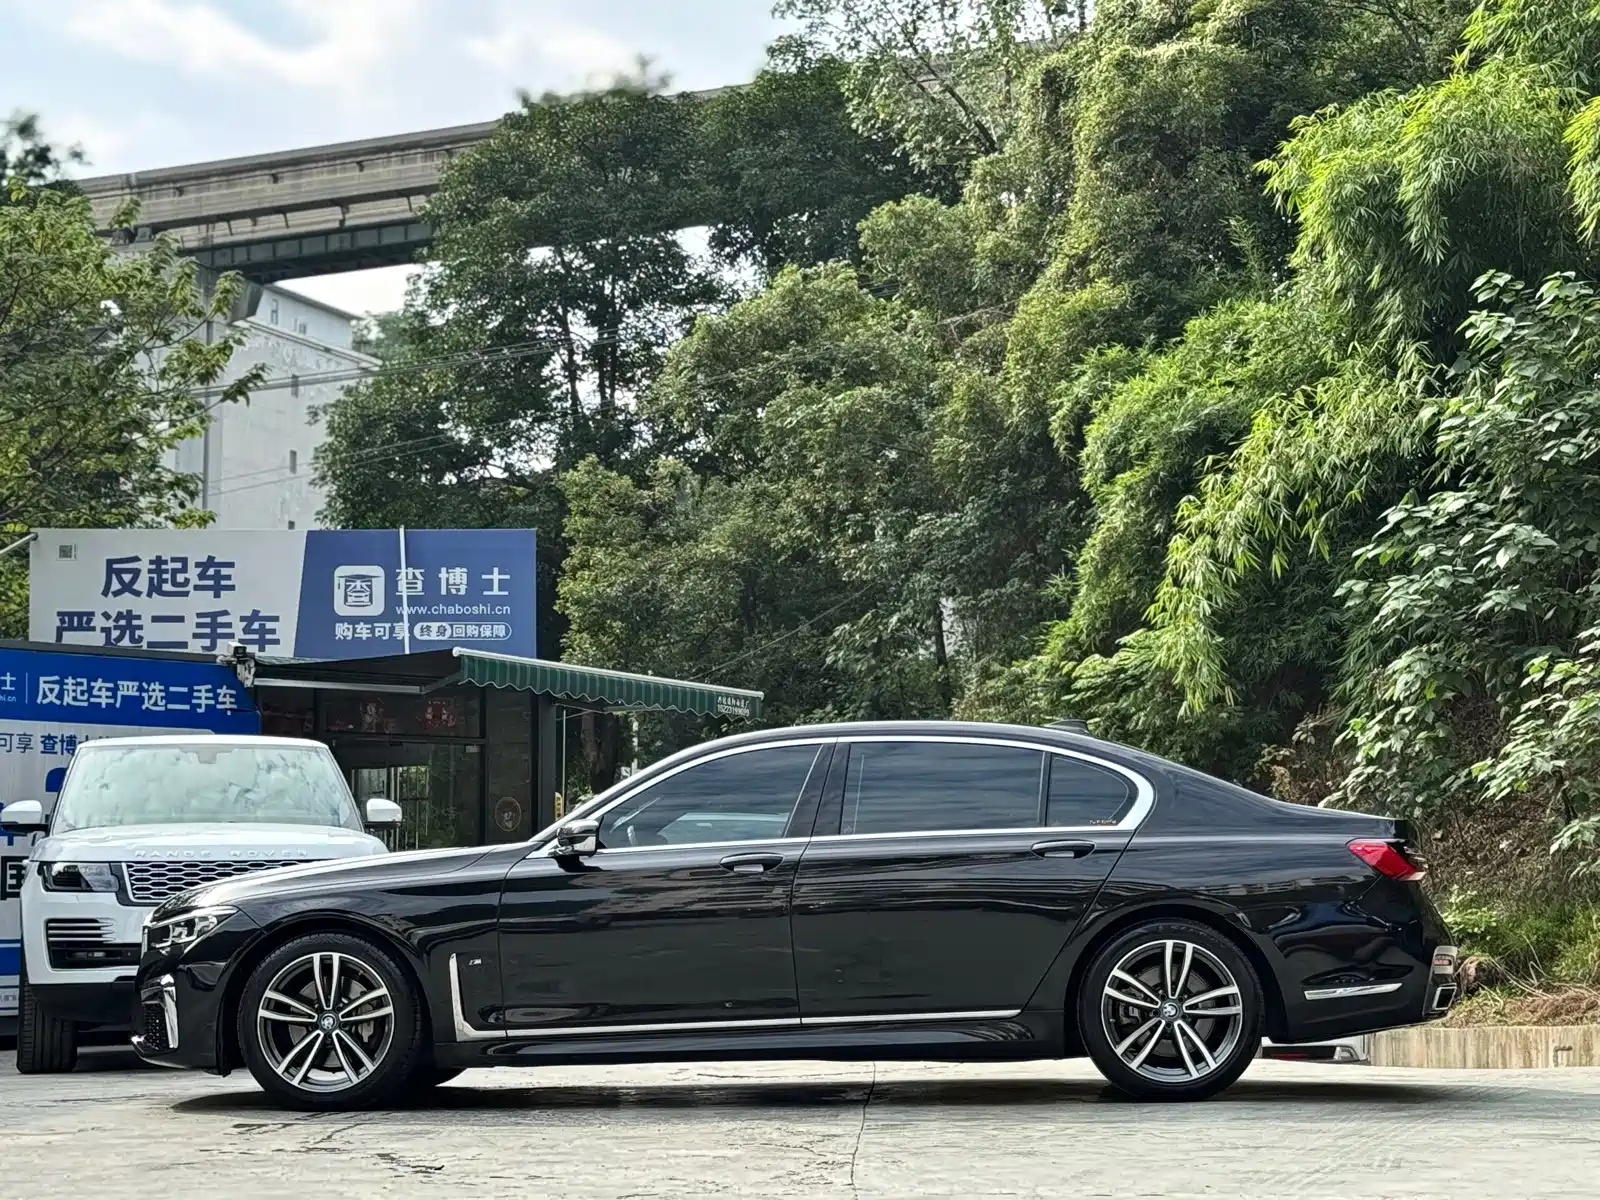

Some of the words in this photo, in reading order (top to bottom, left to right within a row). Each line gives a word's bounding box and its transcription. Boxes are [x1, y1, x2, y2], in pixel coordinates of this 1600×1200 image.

[101, 555, 236, 599] 反起车
[396, 567, 511, 596] 查博士
[395, 603, 511, 615] www.chaboshi.cn
[55, 609, 281, 652] 严选二手车
[36, 675, 238, 716] 反起车严选二手车
[40, 733, 90, 756] 查博
[134, 850, 212, 858] RANGE
[228, 850, 308, 858] ROVER
